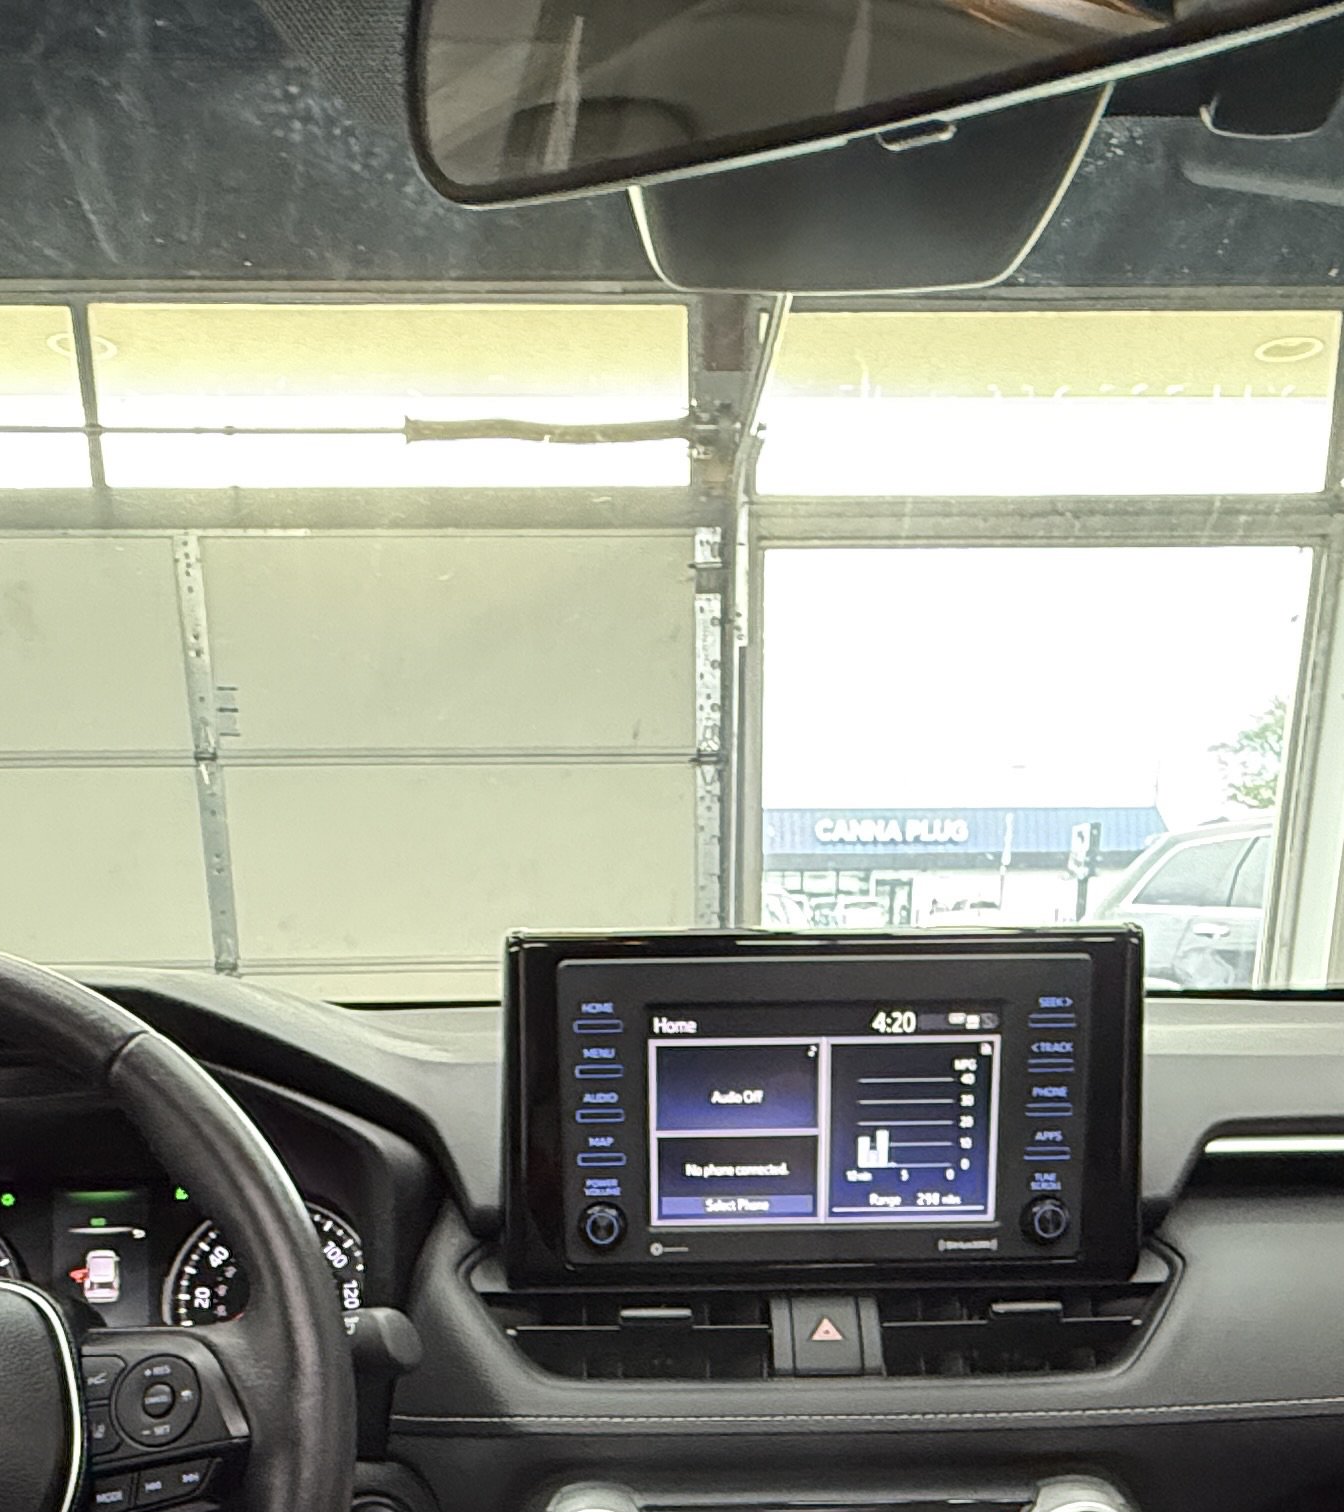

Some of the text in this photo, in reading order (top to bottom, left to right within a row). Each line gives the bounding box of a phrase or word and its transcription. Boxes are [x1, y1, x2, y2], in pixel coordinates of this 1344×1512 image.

[814, 817, 969, 842] CANNA PLUG
[581, 1003, 614, 1013] HOME
[653, 1017, 697, 1034] Home
[871, 1011, 917, 1033] 4:20
[583, 1048, 616, 1059] MENU
[583, 1092, 619, 1103] AUDIO
[711, 1090, 764, 1104] Audio Off
[1031, 1087, 1068, 1097] PHONE
[588, 1137, 614, 1147] MAP
[1035, 1131, 1063, 1141] APPS
[685, 1162, 790, 1178] No phone connected.
[705, 1198, 769, 1212] Select Phone
[869, 1192, 902, 1207] Range
[208, 1245, 230, 1268] 40
[323, 1240, 349, 1269] 100
[194, 1286, 211, 1309] 20
[343, 1279, 360, 1310] 120
[95, 1490, 123, 1504] MODE
